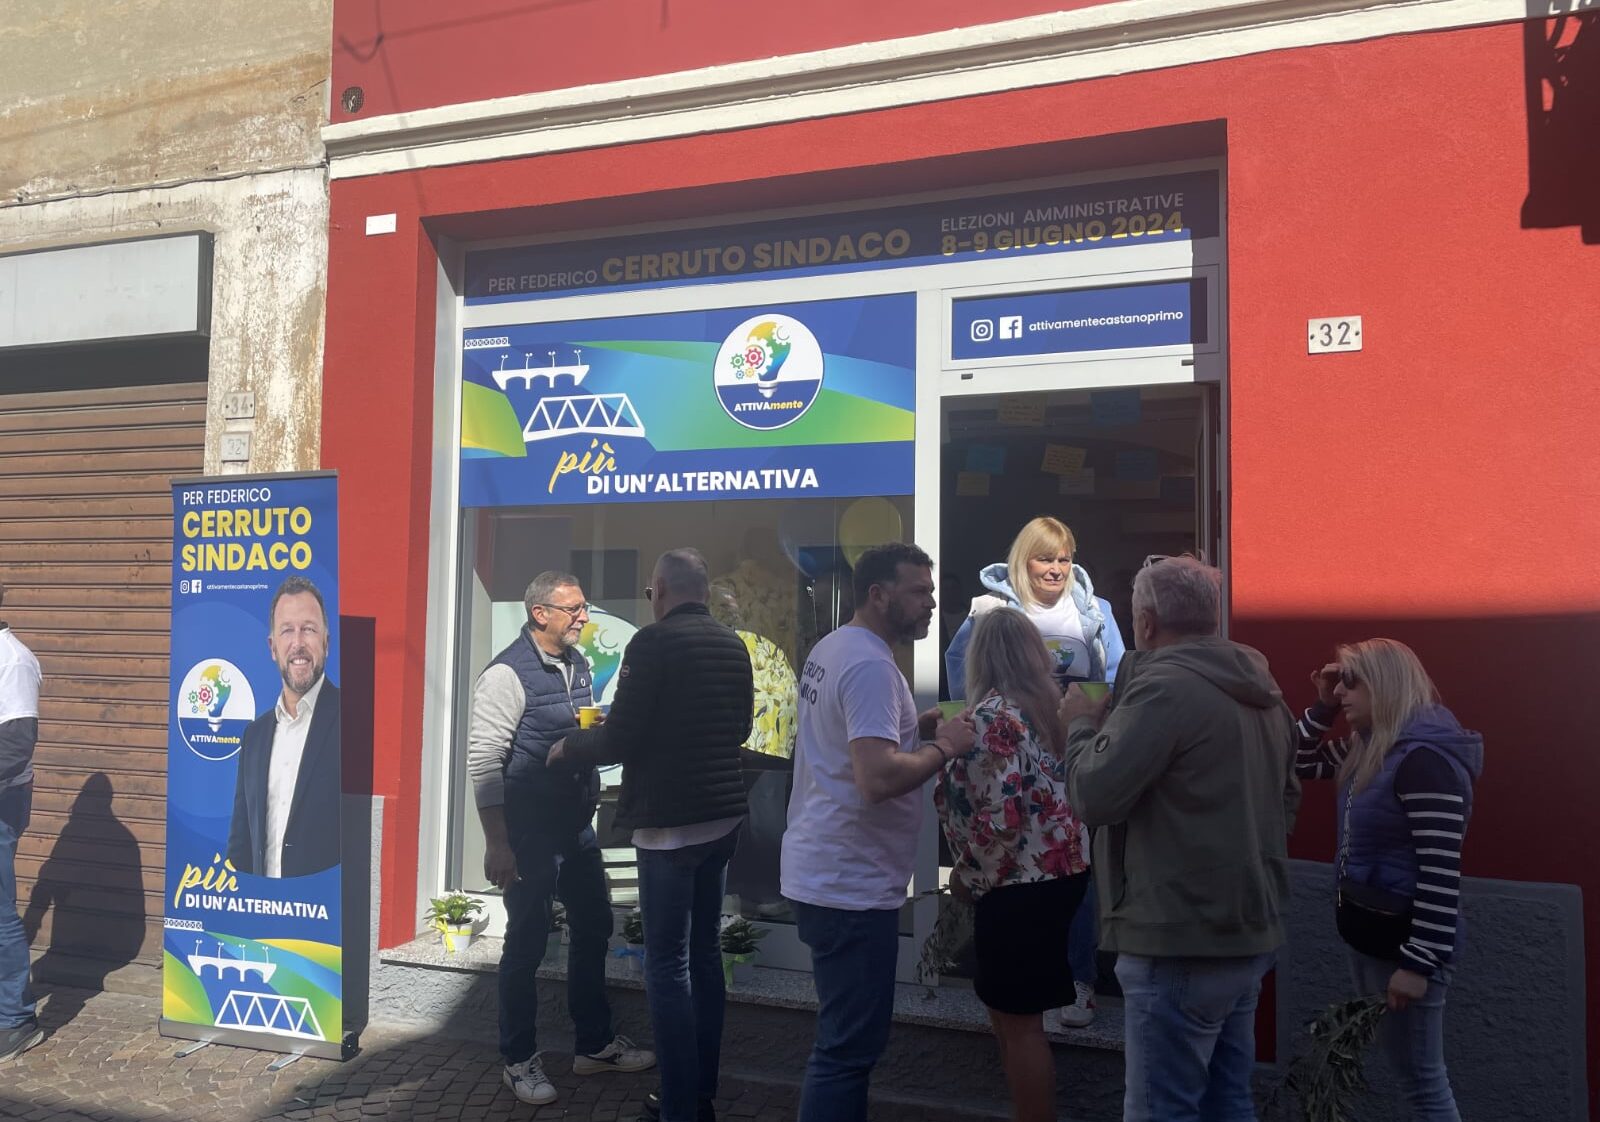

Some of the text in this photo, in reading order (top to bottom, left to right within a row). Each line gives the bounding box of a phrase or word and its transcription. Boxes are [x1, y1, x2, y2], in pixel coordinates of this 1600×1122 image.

[941, 192, 1184, 232] ELEZIONI AMMINISTRATIVE
[942, 211, 1183, 256] 8-9 GIUGNO 2024
[488, 228, 911, 292] PER FEDERICO CERRUTO SINDACO
[1029, 311, 1183, 331] attivamentecastanoprimo
[1320, 321, 1351, 346] 32
[231, 396, 248, 414] 34
[734, 400, 803, 412] ATTIVAmente
[548, 438, 617, 494] più
[587, 468, 819, 494] DI UN'ALTERNATIVA
[183, 487, 271, 505] PER FEDERICO
[182, 506, 312, 538] CERRUTO
[181, 541, 312, 571] SINDACO
[190, 734, 241, 744] ATTIVAmente
[174, 853, 239, 909] più
[185, 893, 329, 920] DI UN'ALTERNATIVA
